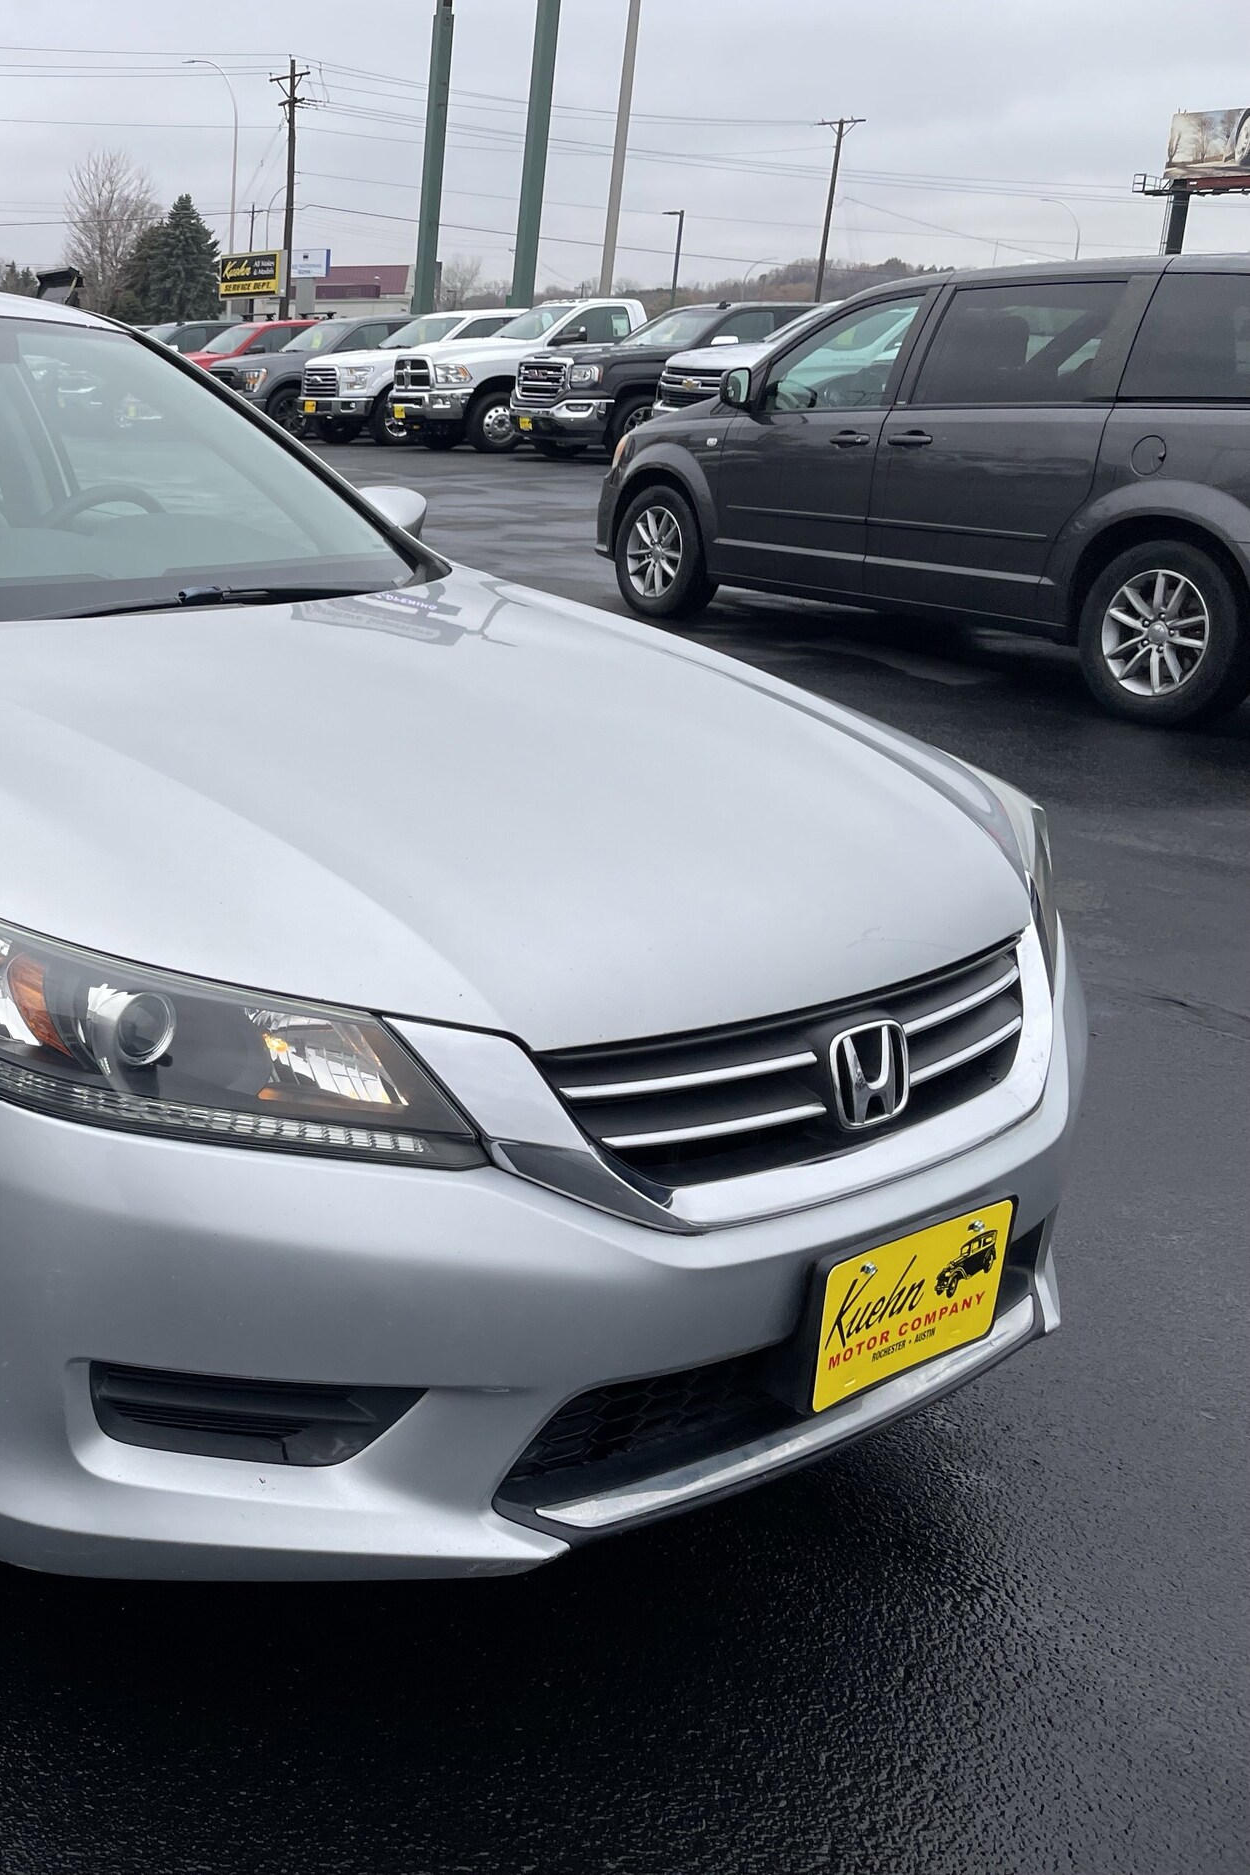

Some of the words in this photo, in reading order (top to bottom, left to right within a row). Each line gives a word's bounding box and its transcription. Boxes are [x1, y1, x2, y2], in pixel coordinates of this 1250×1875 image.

[223, 259, 251, 280] Kuehn
[224, 283, 252, 292] SERVICE
[253, 281, 272, 290] DEPT.
[825, 1255, 926, 1350] Kuehn
[828, 1330, 895, 1370] MOTOR
[898, 1291, 986, 1337] COMPANY
[871, 1342, 906, 1362] ROCHESTER
[914, 1327, 937, 1344] AUSTIN
